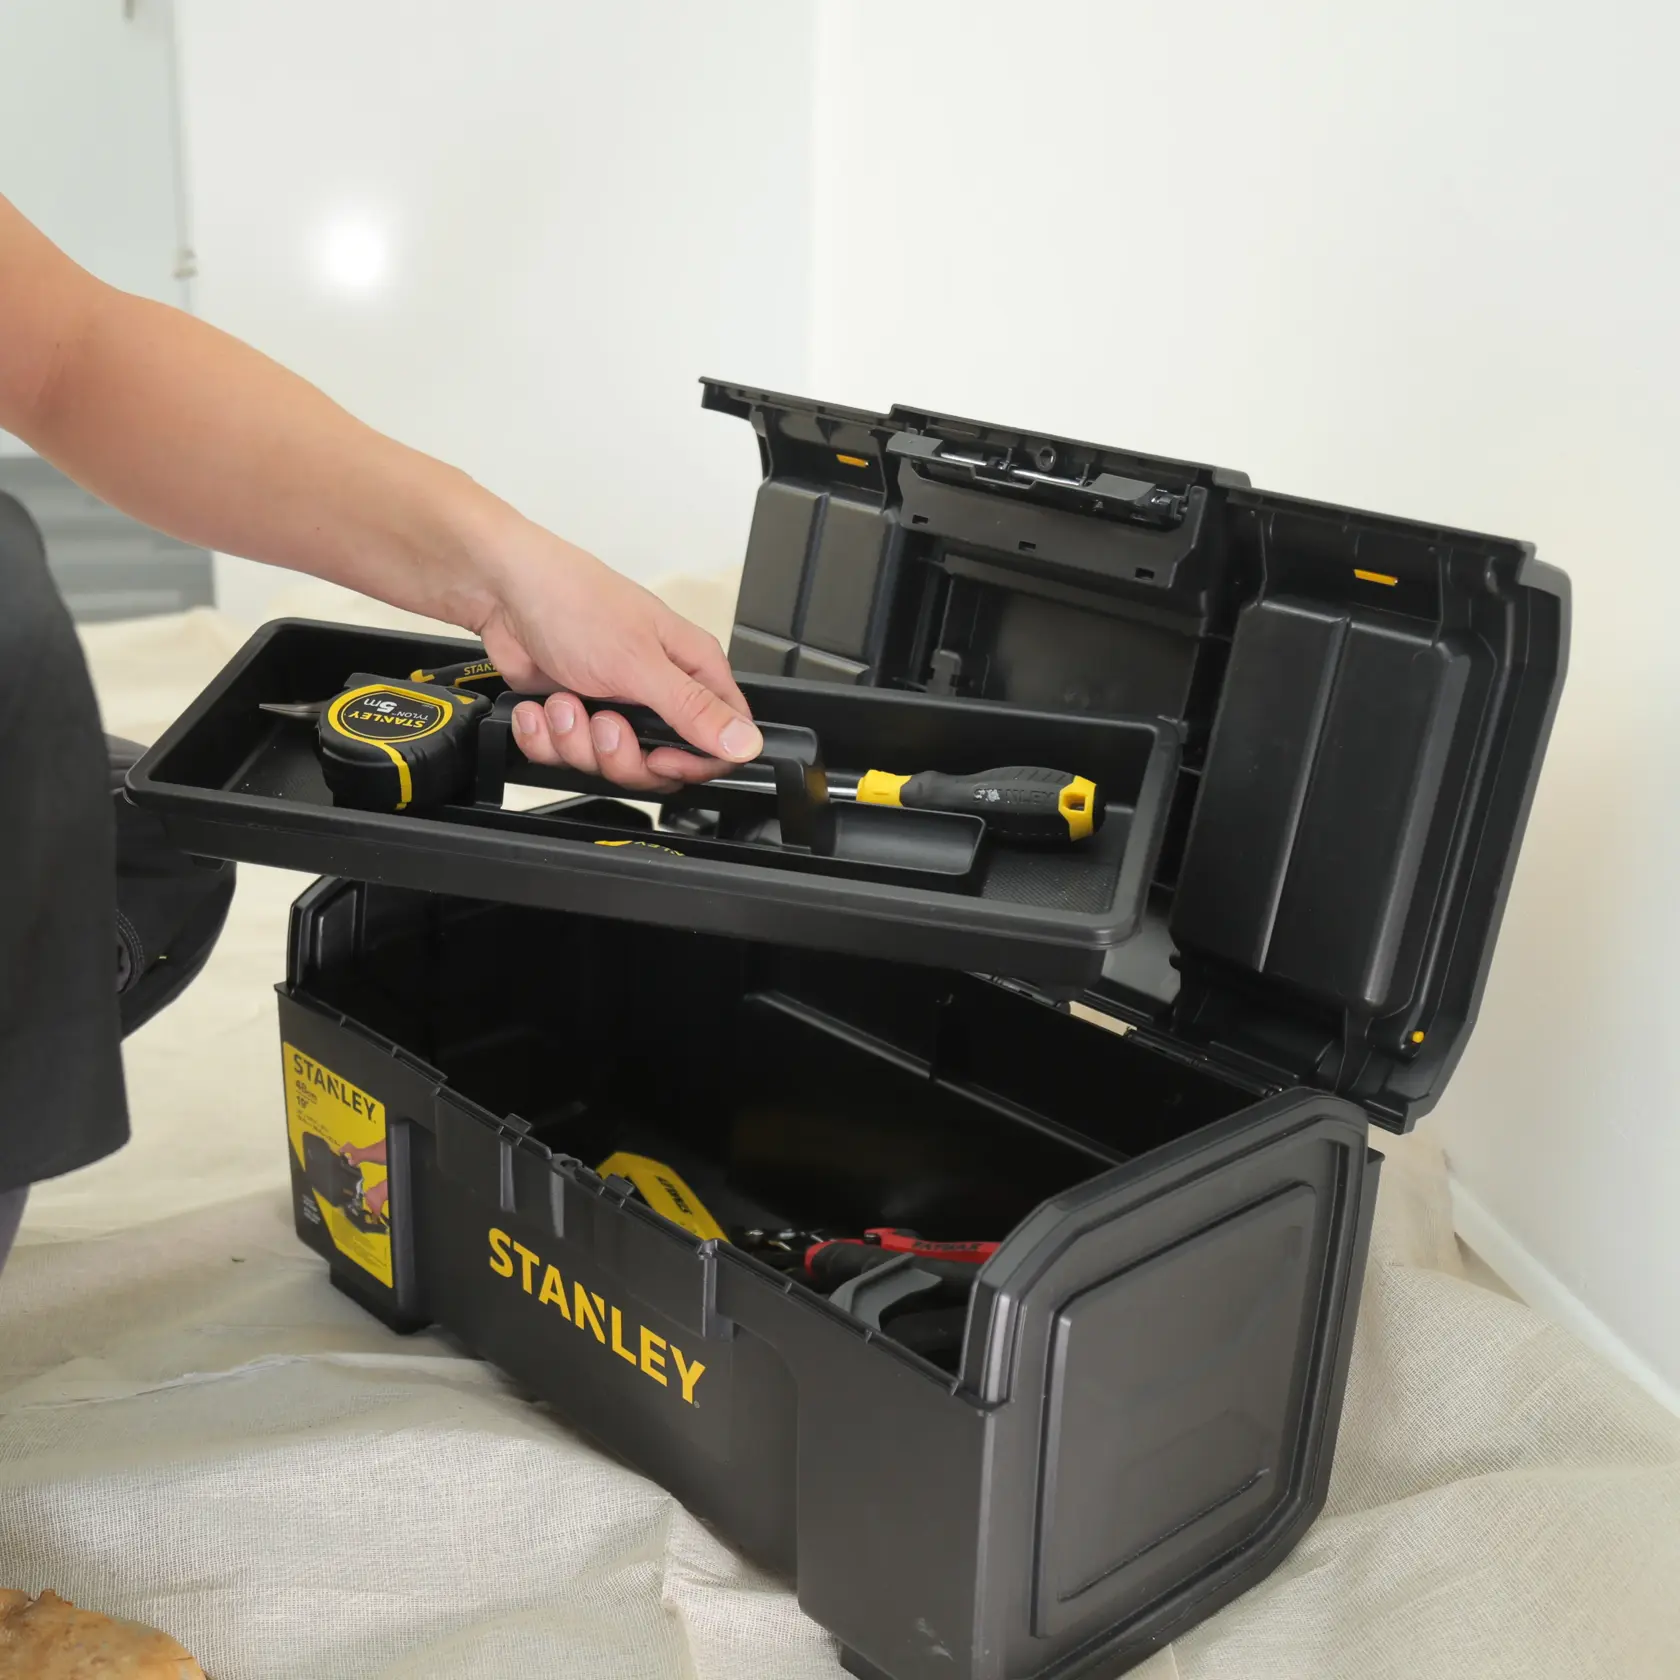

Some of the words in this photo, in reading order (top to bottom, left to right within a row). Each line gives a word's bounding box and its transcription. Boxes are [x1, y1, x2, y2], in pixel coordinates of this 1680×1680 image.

[348, 710, 426, 728] STANLEY
[363, 697, 398, 714] 5m
[293, 1053, 376, 1121] STANLEY
[488, 1227, 706, 1405] STANLEY
